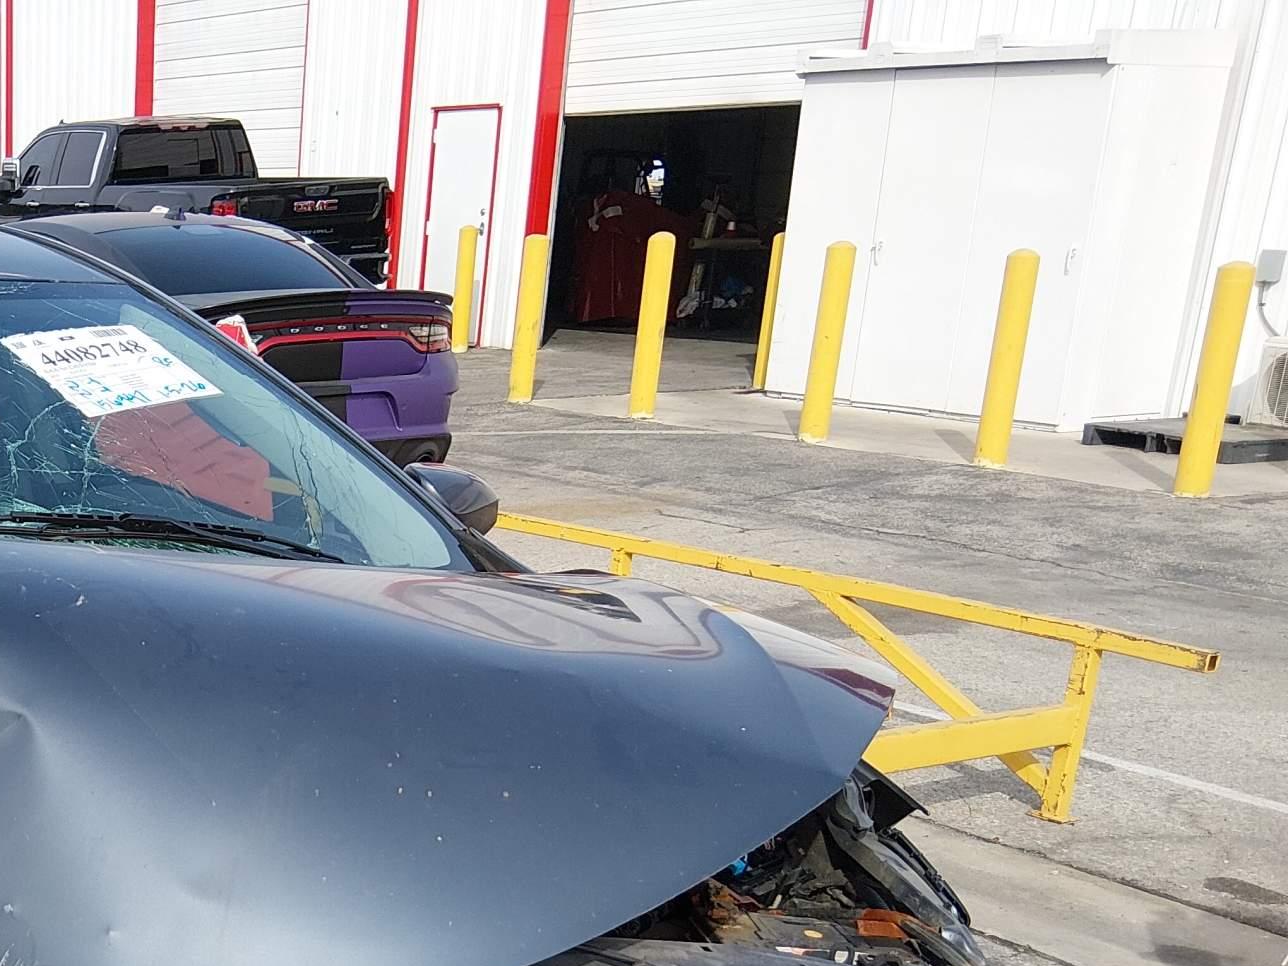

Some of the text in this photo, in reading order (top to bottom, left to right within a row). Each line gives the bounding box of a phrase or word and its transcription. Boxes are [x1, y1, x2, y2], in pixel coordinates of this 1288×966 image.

[293, 199, 339, 213] GMC
[290, 323, 388, 334] DODGE
[41, 339, 147, 368] 44082748
